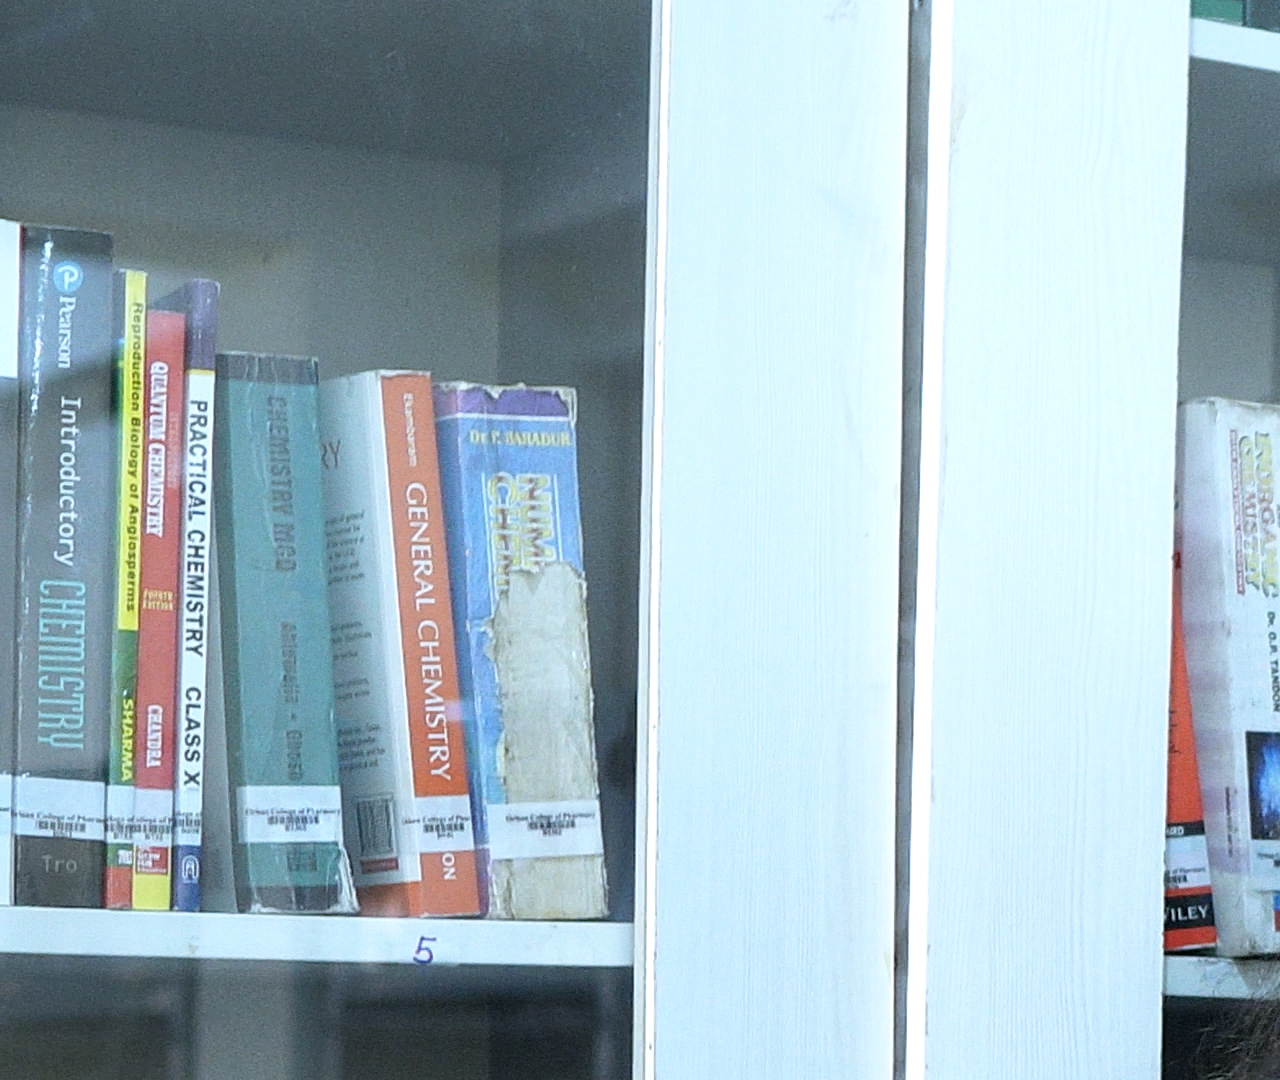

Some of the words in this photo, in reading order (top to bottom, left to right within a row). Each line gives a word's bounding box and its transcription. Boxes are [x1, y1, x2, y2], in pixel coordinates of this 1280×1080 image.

[57, 296, 77, 369] Pearson
[130, 302, 144, 411] Reproduction
[53, 396, 82, 566] Introductory
[127, 417, 141, 477] Biology
[129, 484, 140, 500] of
[188, 401, 208, 521] PRACTICAL
[125, 505, 139, 612] Angiosperms
[186, 530, 207, 657] CHEMISTRY
[405, 482, 433, 612] GENERAL
[36, 580, 87, 751] CHEMISTRY
[418, 619, 450, 781] CHEMISTRY
[1271, 659, 1280, 713] TANDON
[121, 698, 134, 781] SHARMA
[185, 687, 200, 762] CLASS
[184, 771, 200, 787] X
[413, 936, 438, 964] 5
